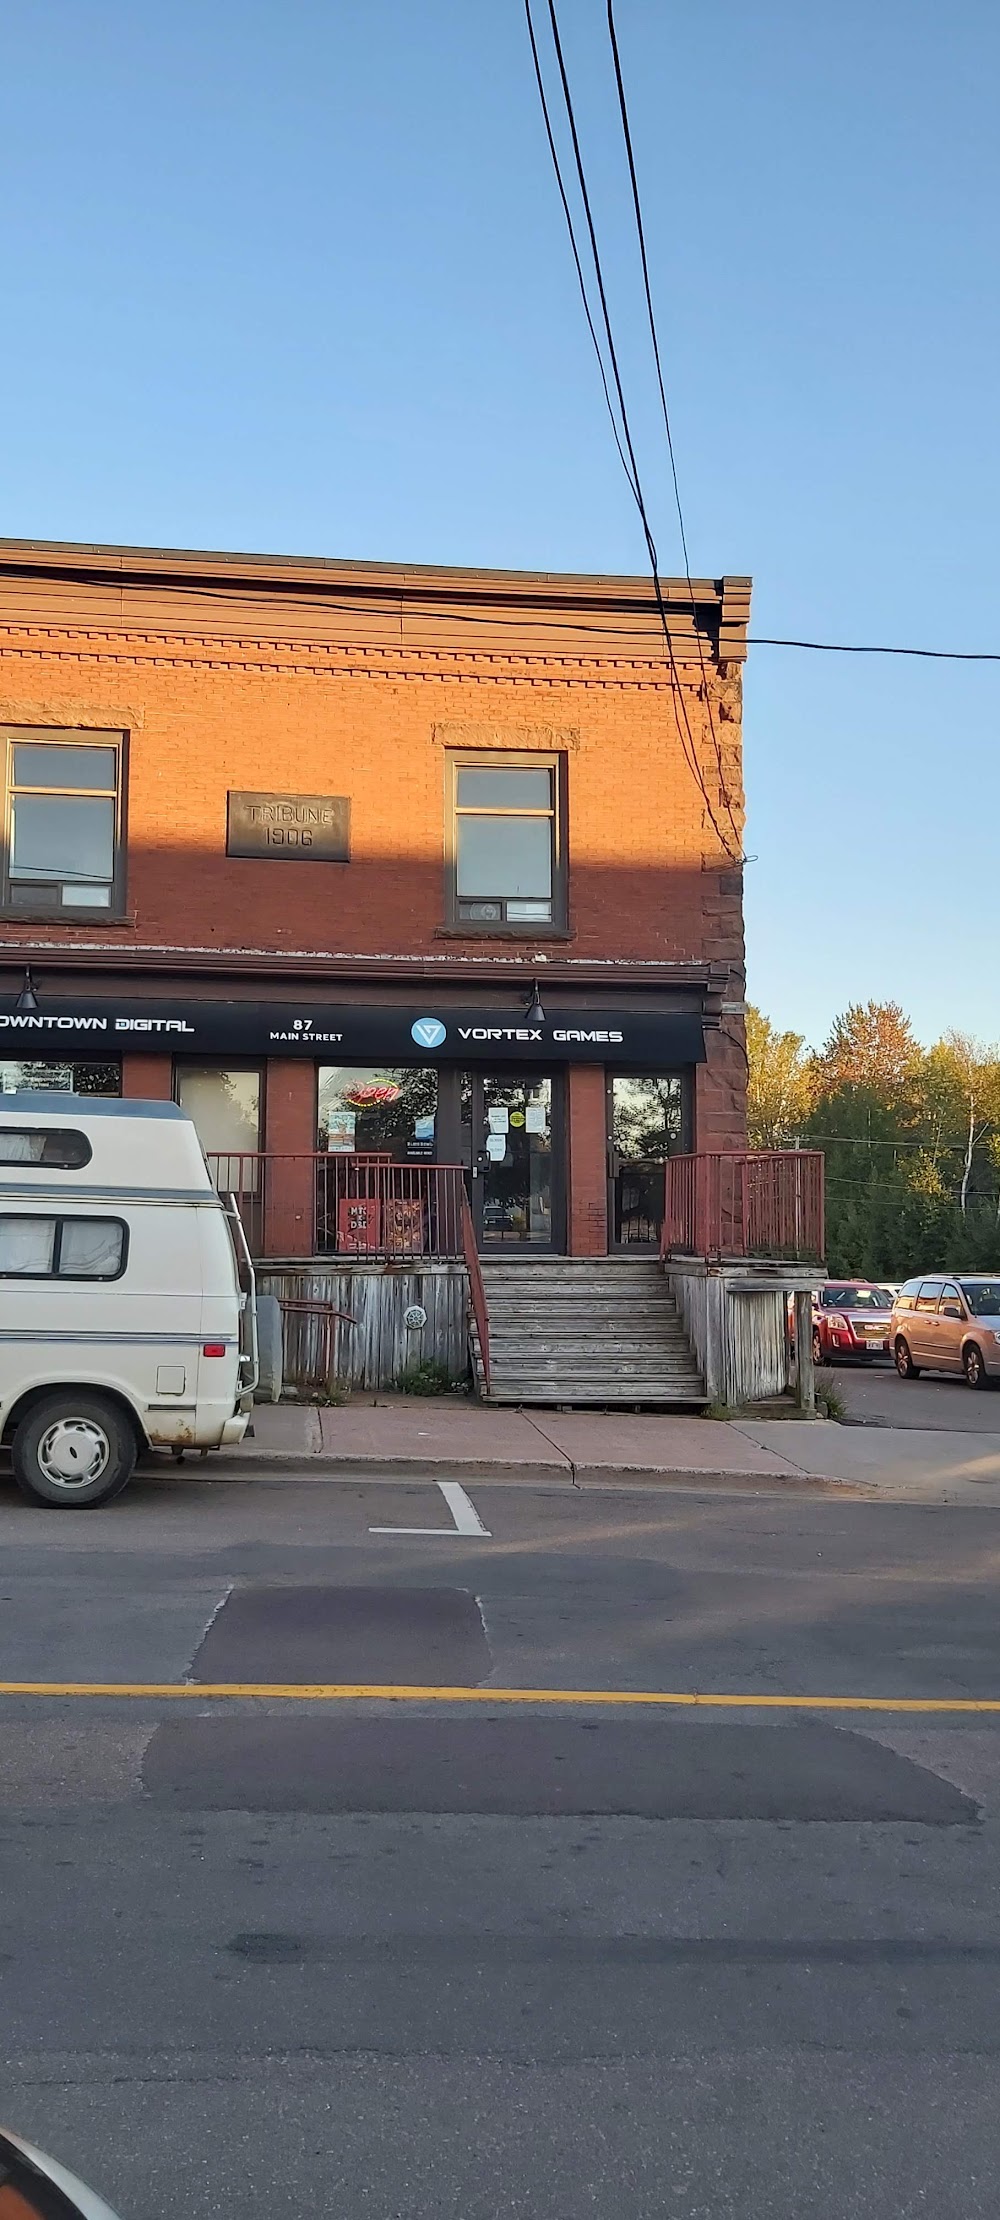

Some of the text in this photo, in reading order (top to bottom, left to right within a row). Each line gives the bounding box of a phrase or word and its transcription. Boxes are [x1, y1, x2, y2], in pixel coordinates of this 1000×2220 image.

[246, 804, 334, 825] TRIBUNE
[266, 827, 313, 846] 1906
[115, 1018, 195, 1032] DIGITAL
[293, 1019, 313, 1031] 87
[269, 1031, 343, 1041] MAIN STREET
[457, 1027, 623, 1043] VORTEX GAMES
